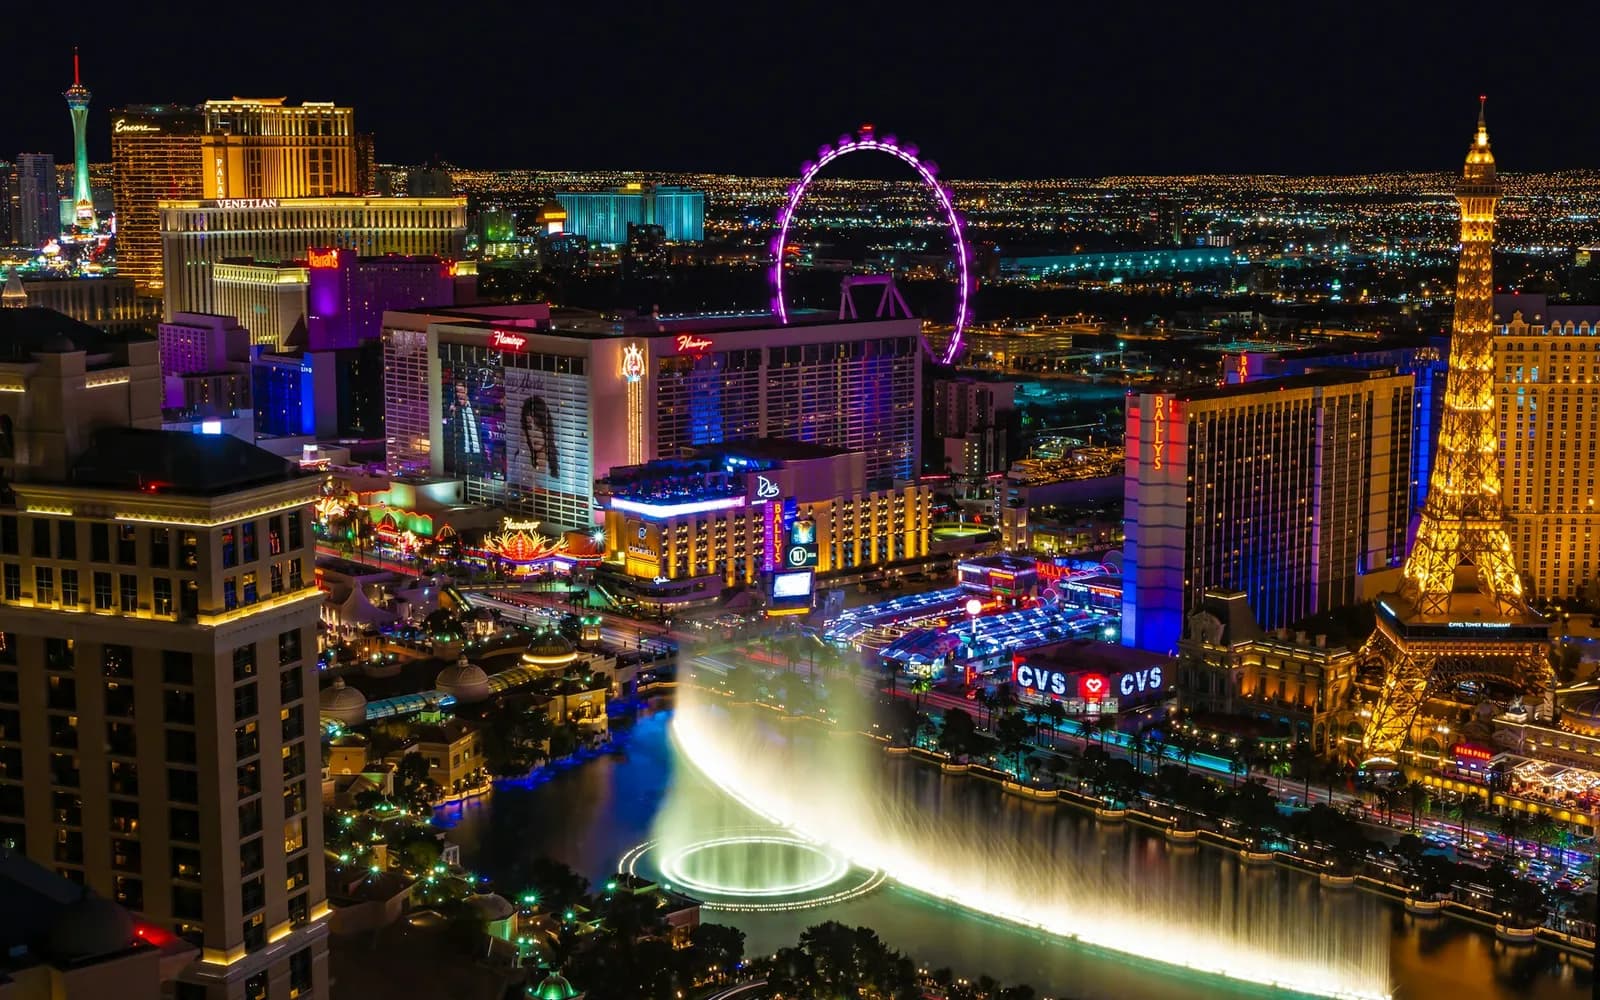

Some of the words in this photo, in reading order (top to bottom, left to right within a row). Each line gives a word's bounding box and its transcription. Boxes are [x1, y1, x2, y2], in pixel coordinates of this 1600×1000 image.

[115, 119, 161, 133] Encore
[216, 199, 278, 209] VENETIAN
[493, 330, 526, 350] Flamingo
[1153, 395, 1165, 470] BALLYS
[503, 516, 541, 533] Flamingo
[1017, 665, 1066, 695] CVS
[1120, 666, 1162, 696] CVS
